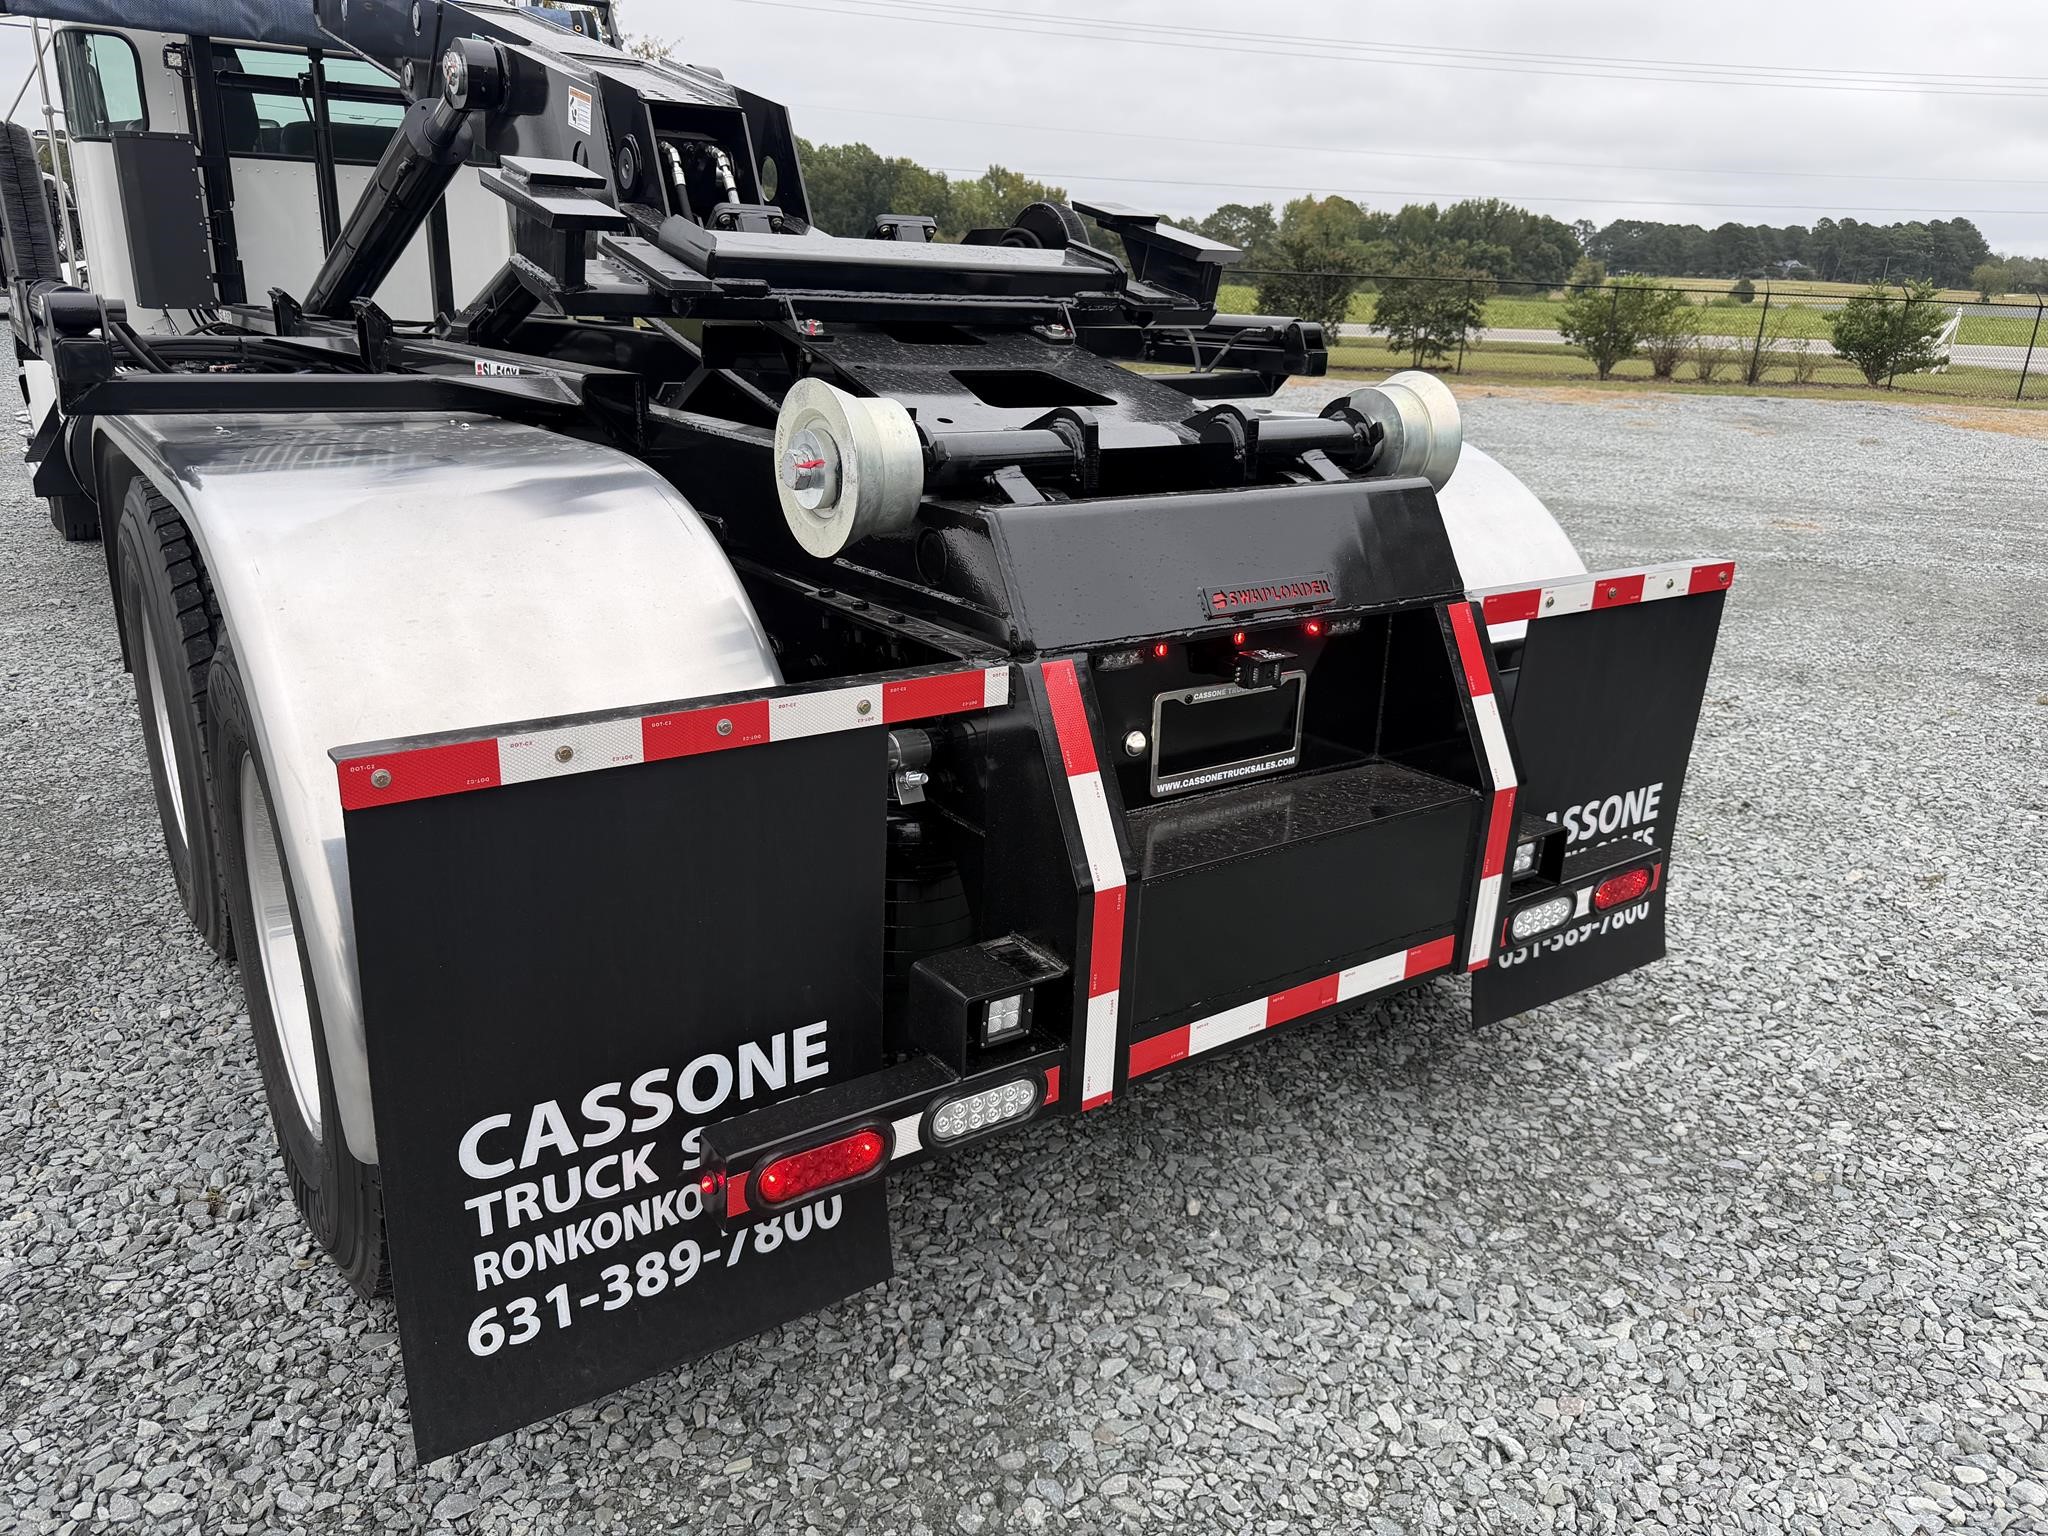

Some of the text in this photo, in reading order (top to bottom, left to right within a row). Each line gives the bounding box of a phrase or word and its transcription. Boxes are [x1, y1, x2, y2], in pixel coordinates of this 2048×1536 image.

[1228, 579, 1331, 606] SWAPLOADER
[1193, 688, 1226, 700] CASSONE
[651, 720, 672, 728] DOT-C2
[350, 764, 375, 773] DOT-C2
[466, 777, 490, 785] DOT-C2
[1157, 756, 1295, 793] WWW.CASSONETRUCKSALES.COM
[1546, 782, 1663, 845] SSONE
[458, 1020, 829, 1180] CASSONE
[464, 1141, 660, 1237] TRUCK
